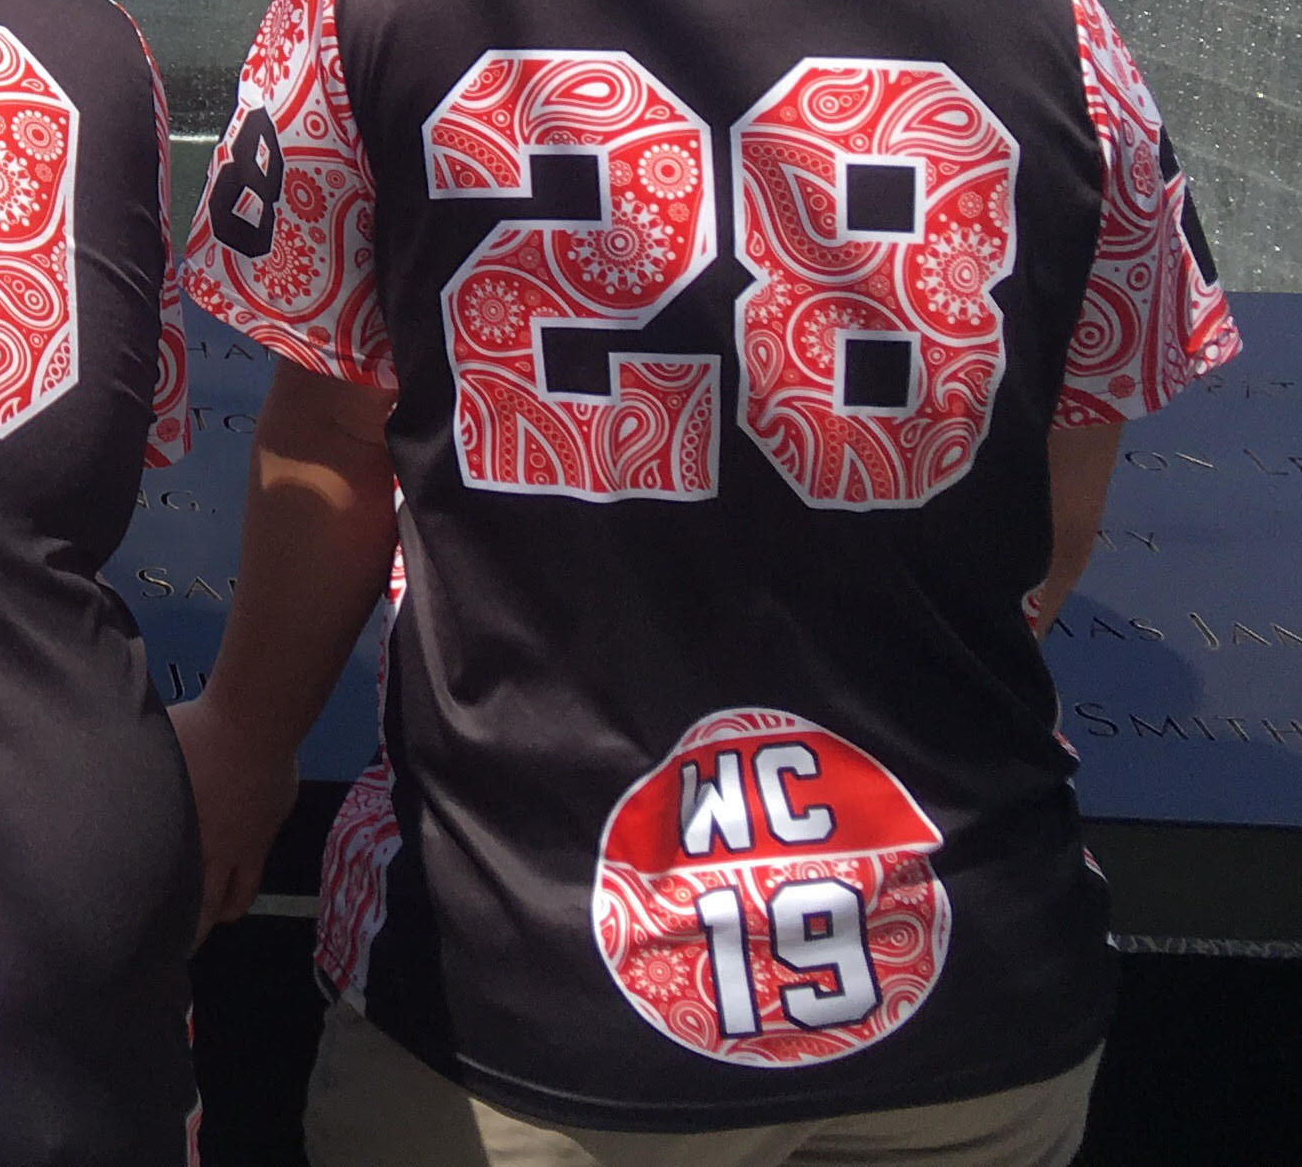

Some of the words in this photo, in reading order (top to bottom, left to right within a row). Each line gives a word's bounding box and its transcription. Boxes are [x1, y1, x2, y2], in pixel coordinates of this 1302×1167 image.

[207, 105, 285, 259] 8
[421, 49, 1021, 510] 28
[679, 740, 838, 859] WC
[696, 877, 884, 1039] 19
